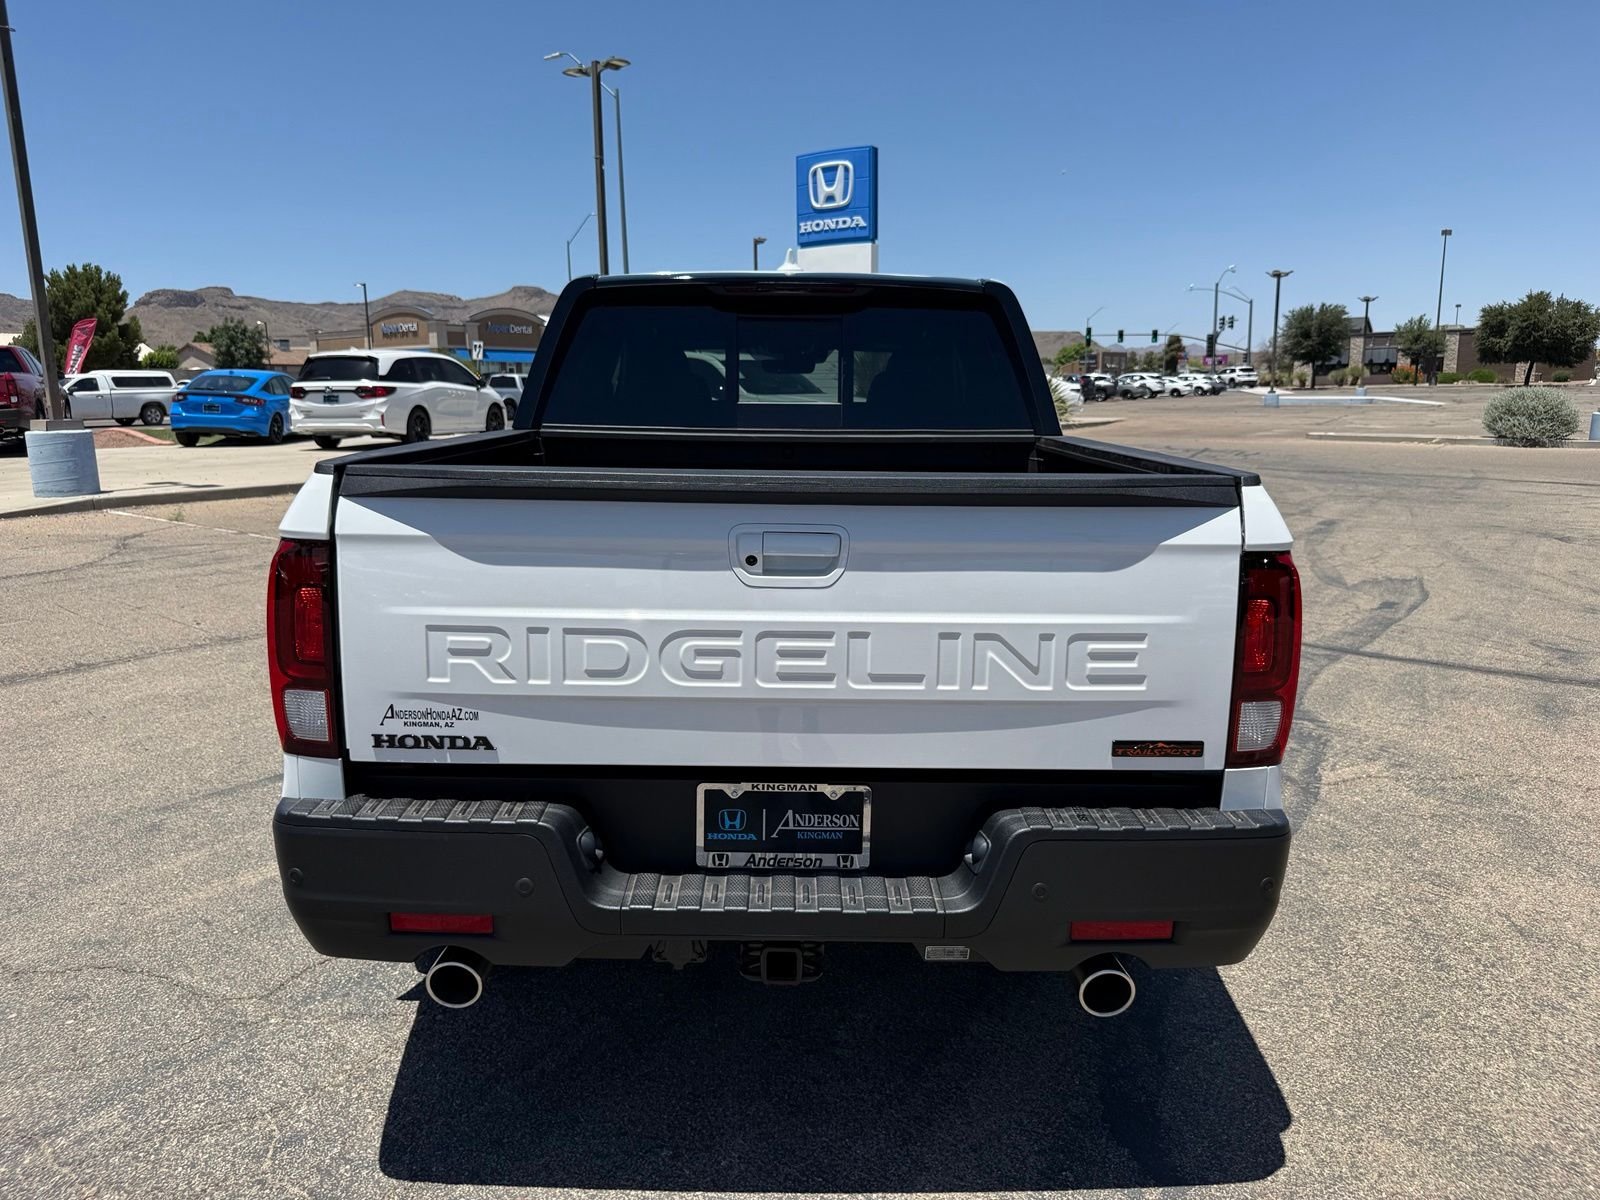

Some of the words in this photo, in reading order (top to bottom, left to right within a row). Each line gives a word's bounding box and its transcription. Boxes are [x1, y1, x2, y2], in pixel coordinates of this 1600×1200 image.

[799, 216, 867, 234] HONDA
[425, 624, 1149, 693] RIDGELINE
[403, 721, 443, 729] KINGMAN,
[371, 734, 498, 751] HONDA
[1114, 748, 1201, 757] TRAILSPORT
[751, 783, 818, 791] KINGMAN
[770, 809, 860, 838] ANDERSON
[706, 832, 758, 841] HONDA
[797, 831, 843, 840] KINGMAN
[743, 853, 823, 868] Anderson
